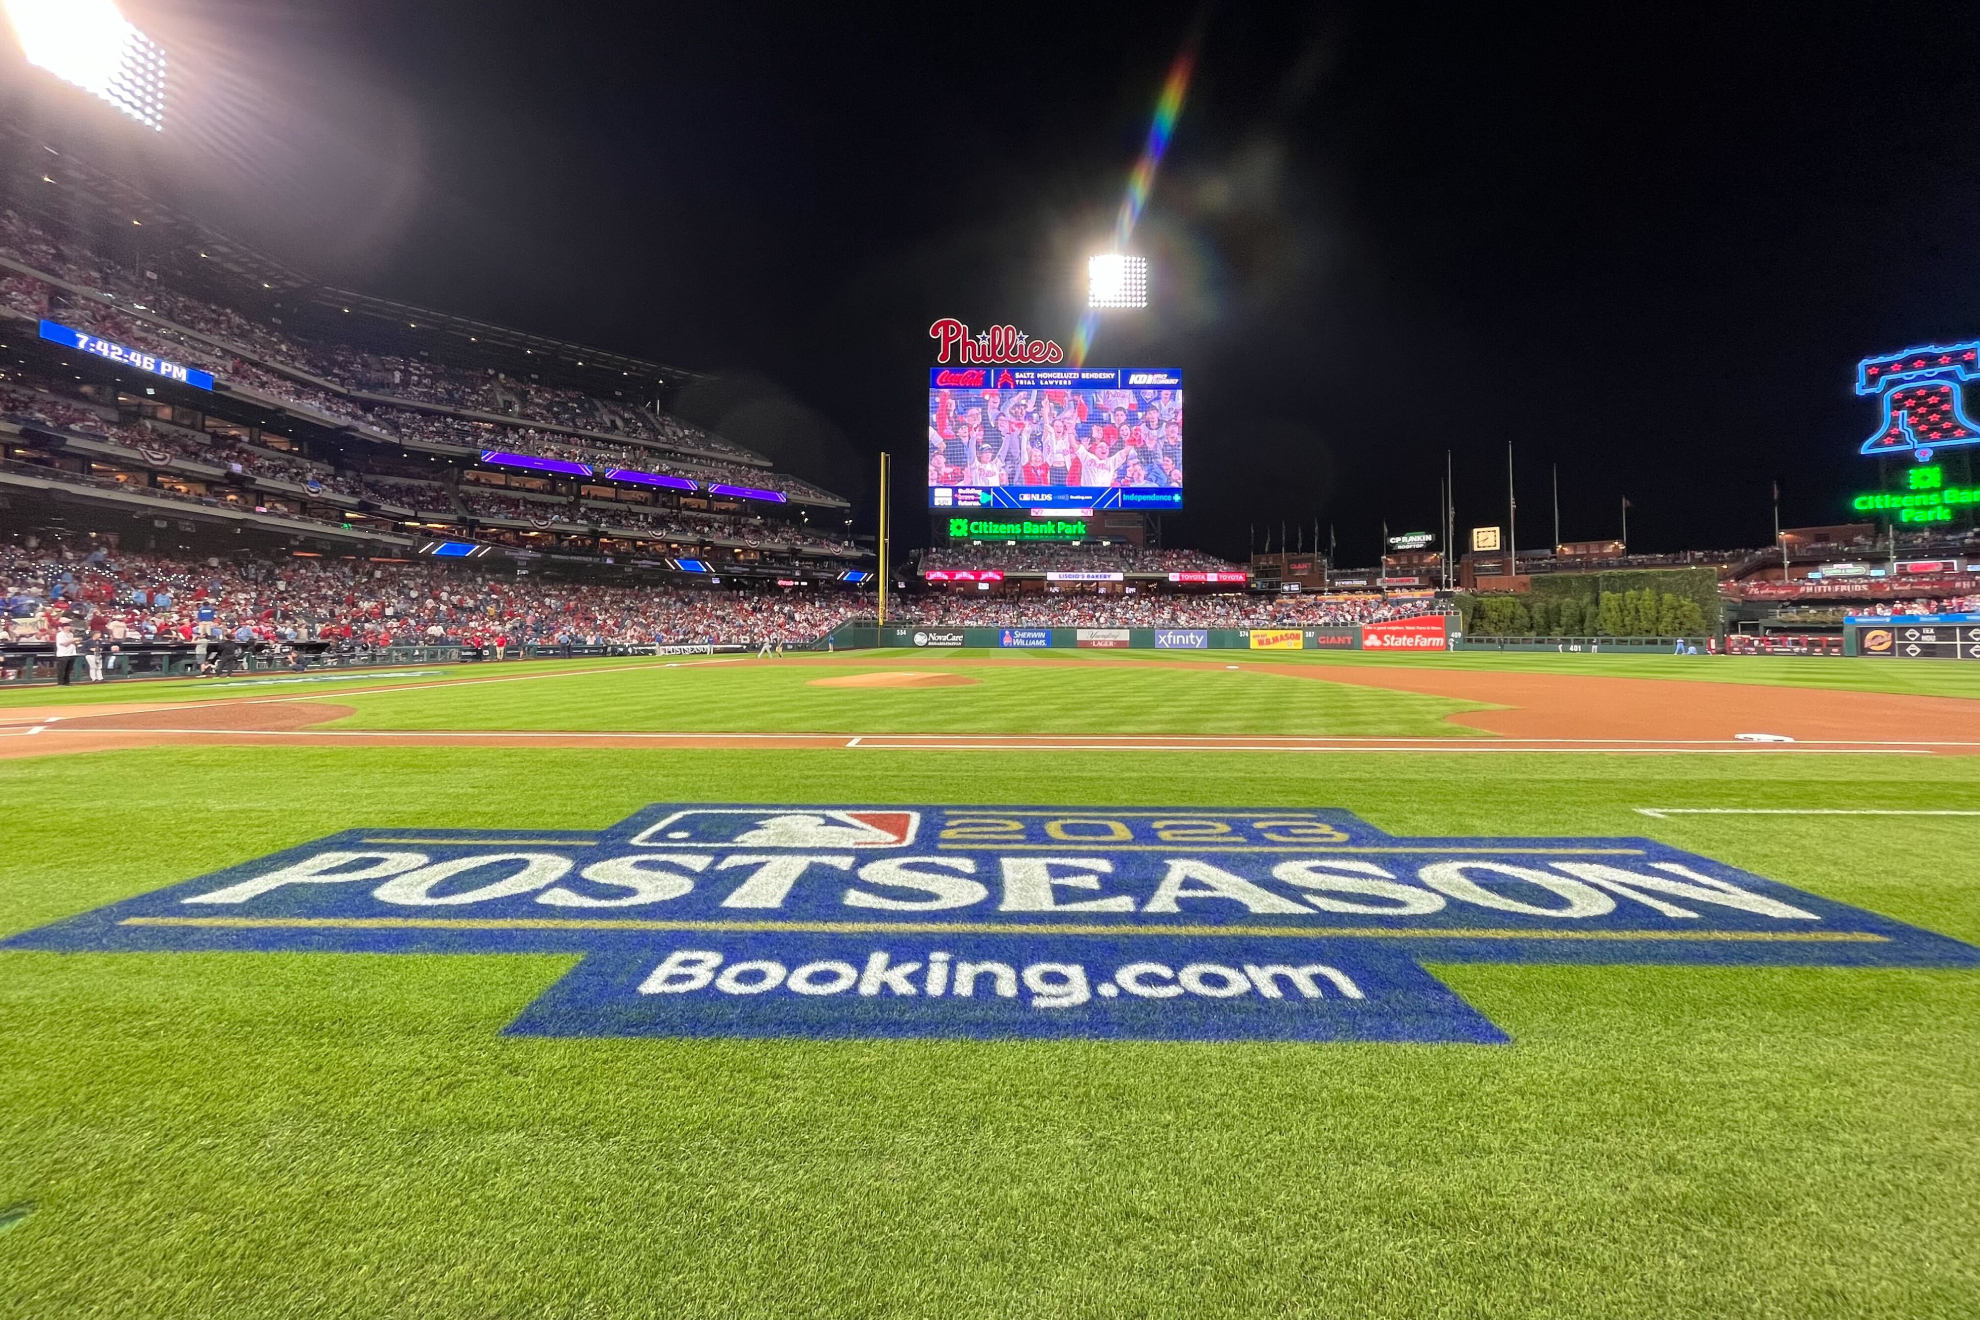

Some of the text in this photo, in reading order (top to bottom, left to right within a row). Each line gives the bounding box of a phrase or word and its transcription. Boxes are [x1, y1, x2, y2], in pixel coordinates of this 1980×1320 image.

[929, 318, 1063, 363] Phillies
[75, 332, 187, 382] 7:42:46 PM
[1031, 493, 1053, 501] NLDS
[1122, 493, 1172, 502] Independence
[1854, 493, 1941, 510] Citizens
[1901, 505, 1952, 522] Park
[970, 521, 1086, 535] Citizens Bank Park
[1401, 534, 1432, 543] RANKIN
[927, 632, 964, 642] NovaCare
[1013, 630, 1046, 639] SHERWIN
[1158, 631, 1204, 648] xfinity
[1318, 636, 1353, 645] GIANT
[938, 818, 1350, 844] 2023
[180, 851, 1822, 921] POSTSEASON
[637, 950, 1365, 1009] Booking.com
